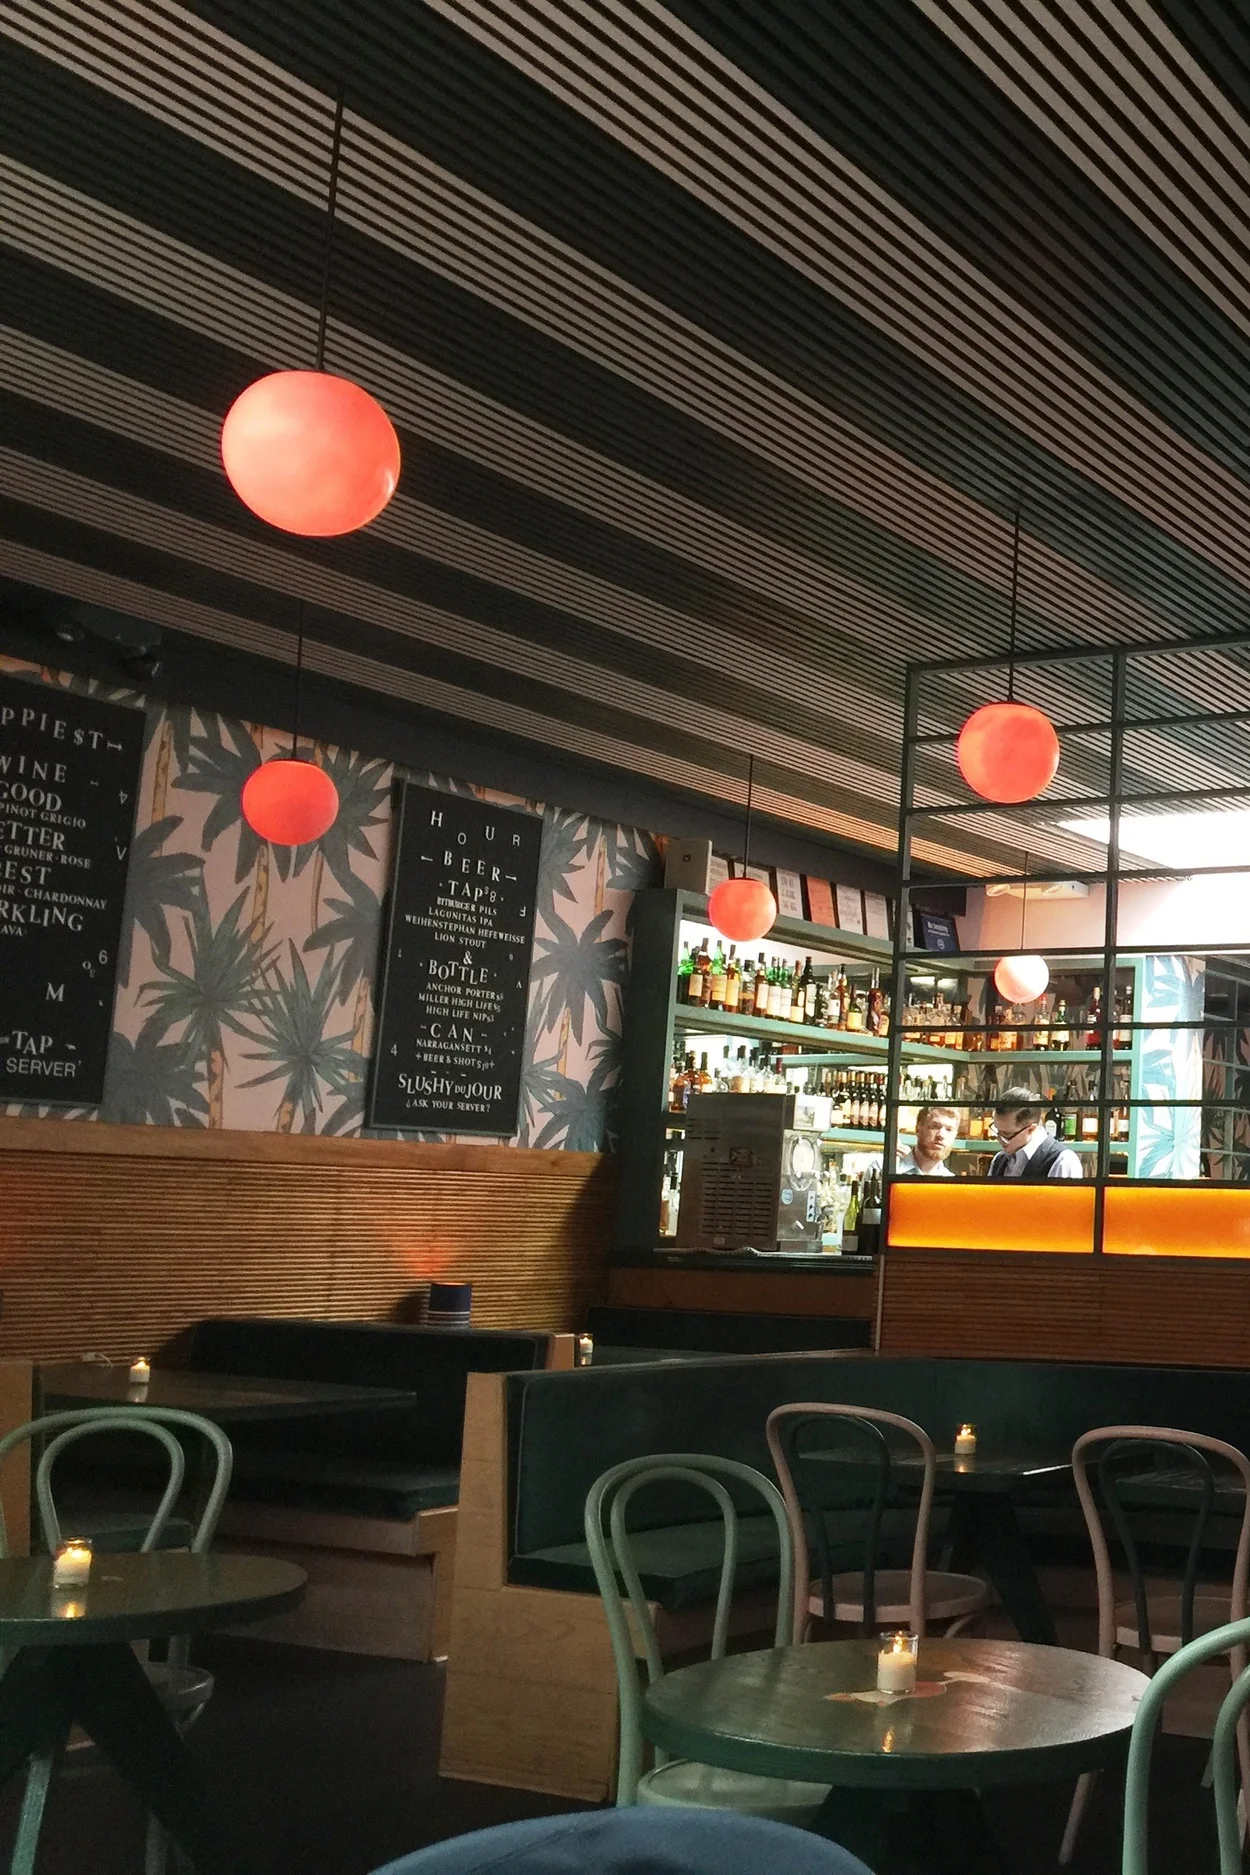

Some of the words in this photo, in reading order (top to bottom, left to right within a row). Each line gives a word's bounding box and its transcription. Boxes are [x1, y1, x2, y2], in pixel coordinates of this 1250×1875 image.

[40, 811, 87, 829] GRIGIO
[4, 844, 54, 862] GRUNER
[60, 853, 92, 870] ROSE
[443, 850, 500, 882] BEER
[0, 860, 51, 886] EST
[24, 887, 108, 911] CHARDONNAY
[428, 906, 477, 924] LAGUNITAS
[479, 917, 494, 928] IPA
[479, 904, 498, 917] PILS
[405, 913, 476, 935] WEIHENSTEPHAN
[478, 927, 526, 945] HEFEWEISSE
[434, 931, 456, 944] LION
[458, 936, 487, 950] STOUT
[428, 959, 489, 985] BOTTLE
[426, 982, 462, 995] ANCHOR
[418, 992, 449, 1005] MILLER
[451, 997, 473, 1009] HIGH
[426, 1005, 449, 1017] HIGH
[452, 1009, 470, 1019] LIFE
[12, 1030, 53, 1056] TAP
[430, 1023, 474, 1043] CAN
[416, 1038, 483, 1053] NARRAGANSETT
[398, 1073, 454, 1096] SLUSHY
[465, 1082, 502, 1101] JOUR
[432, 1099, 454, 1110] YOUR
